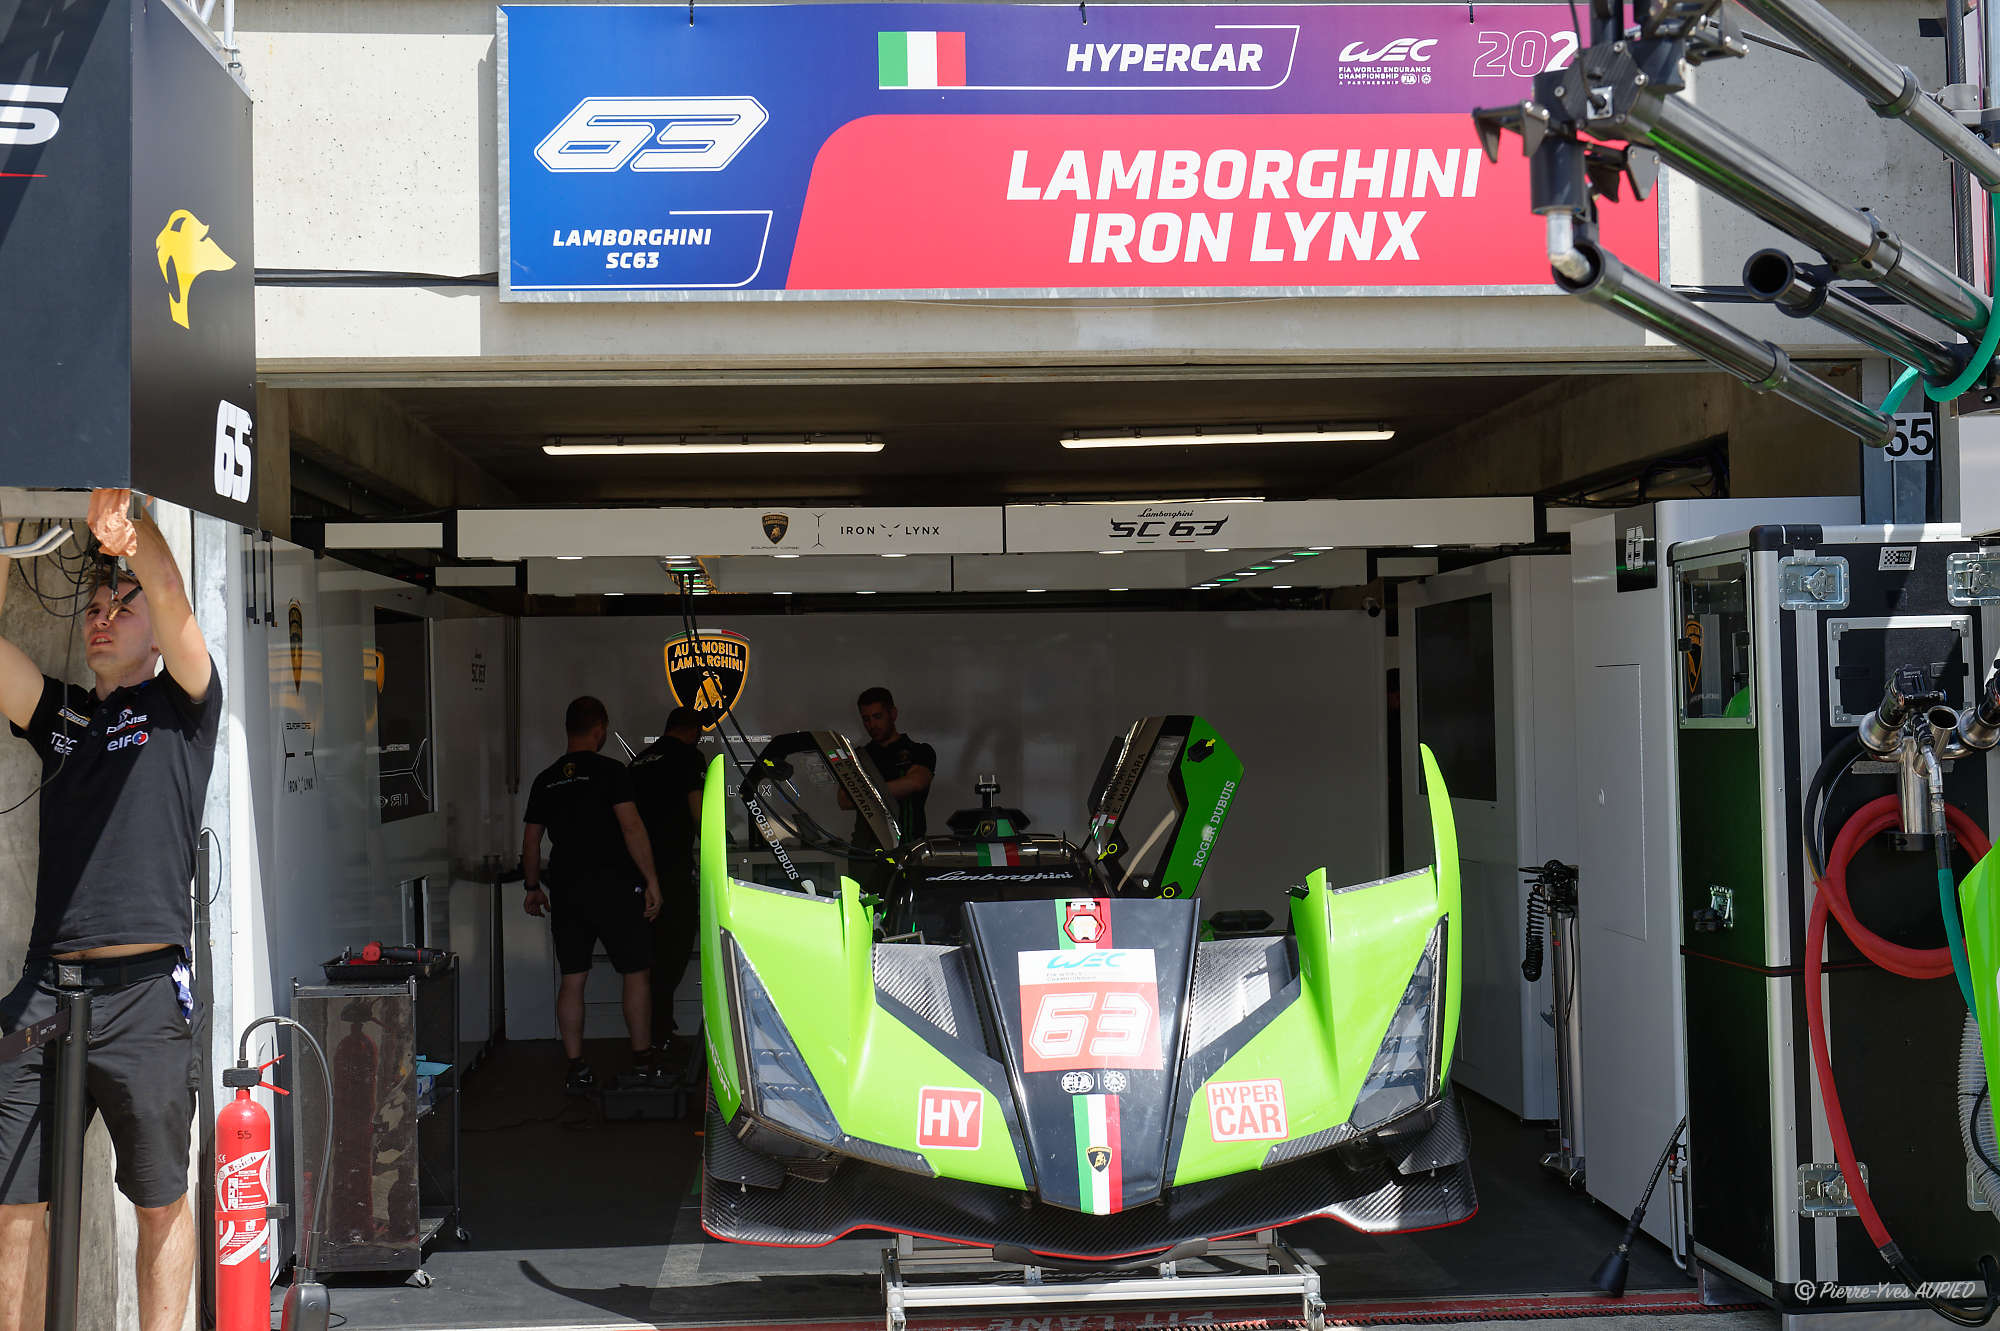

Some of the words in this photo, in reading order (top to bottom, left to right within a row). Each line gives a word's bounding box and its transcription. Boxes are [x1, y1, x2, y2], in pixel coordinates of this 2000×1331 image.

[1066, 43, 1263, 72] HYPERCAR
[1338, 38, 1439, 62] WEC
[534, 95, 769, 173] 63
[1006, 148, 1483, 200] LAMBORGHINI
[553, 228, 712, 247] LAMBORGHINI
[1068, 211, 1233, 263] IRON
[1250, 210, 1428, 263] LYNX
[605, 252, 660, 269] SC63
[214, 399, 252, 504] 65
[1884, 418, 1934, 457] 55
[1137, 508, 1194, 518] Lamborghini
[841, 526, 876, 535] IRON
[905, 526, 940, 535] LYNX
[1193, 825, 1218, 868] ROGER
[1210, 780, 1236, 826] DUBUIS
[747, 799, 775, 840] ROGER
[769, 838, 800, 881] DUBUIS
[926, 870, 1074, 882] Lamborghini
[1046, 951, 1129, 969] WEC
[1029, 991, 1153, 1059] 63
[1212, 1085, 1278, 1105] HYPER
[923, 1098, 979, 1138] HY
[1215, 1103, 1282, 1136] CAR
